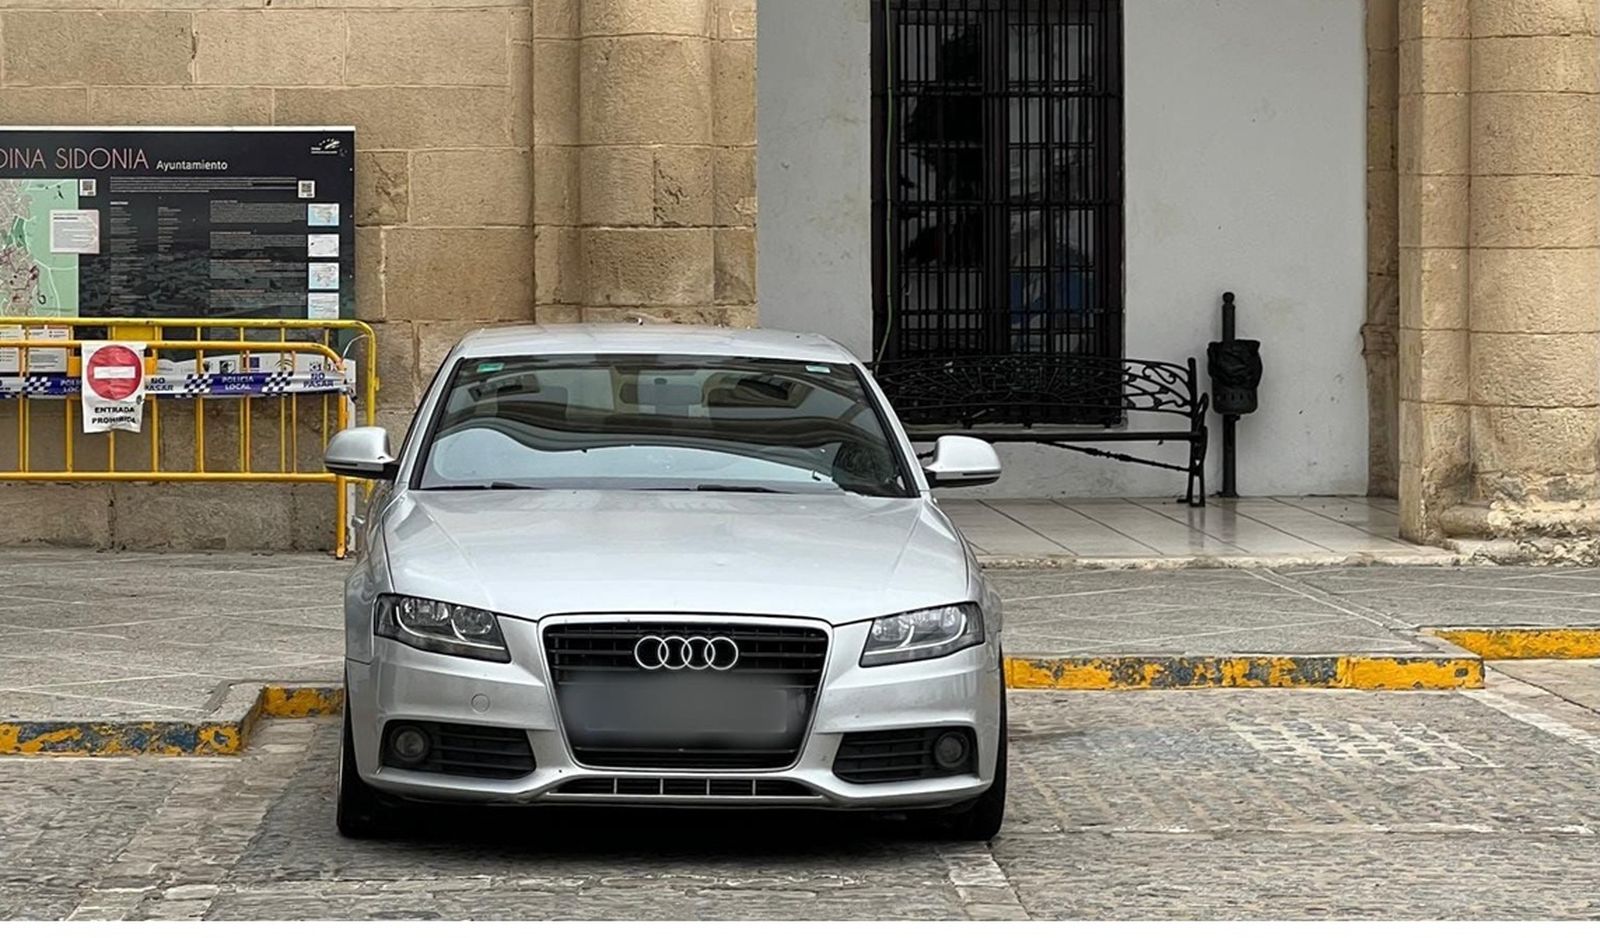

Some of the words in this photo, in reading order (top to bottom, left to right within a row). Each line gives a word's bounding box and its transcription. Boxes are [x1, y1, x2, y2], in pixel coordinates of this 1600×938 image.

[56, 147, 149, 170] SIDONIA
[156, 159, 228, 172] Ayuntamiento
[311, 372, 325, 380] NO
[225, 383, 252, 391] LOCAL
[303, 379, 334, 388] PASAR
[94, 406, 135, 414] ENTRADA
